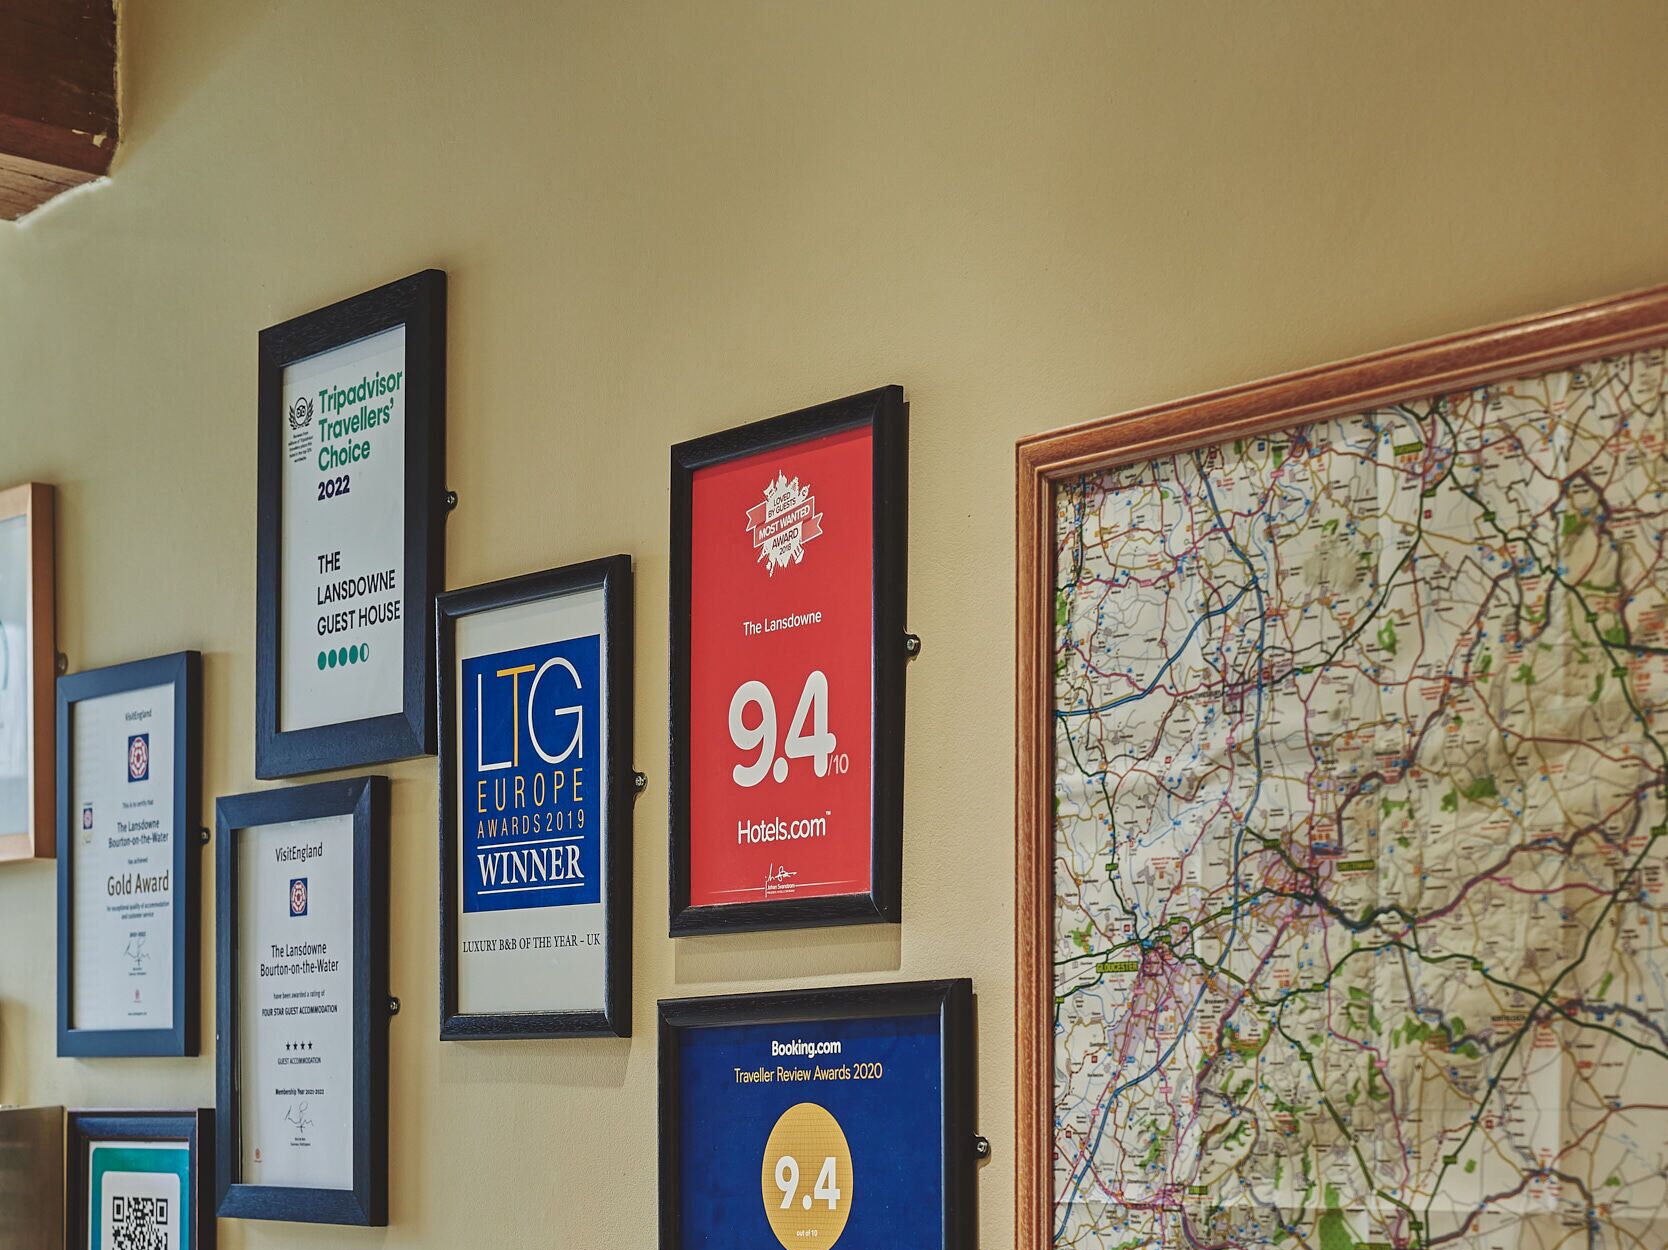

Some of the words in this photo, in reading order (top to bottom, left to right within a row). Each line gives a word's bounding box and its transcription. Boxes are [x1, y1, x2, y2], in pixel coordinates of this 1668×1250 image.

[318, 371, 403, 415] Tripadvisor
[318, 438, 370, 471] Choice
[318, 474, 350, 501] 2022
[774, 491, 790, 506] LOVED
[768, 508, 775, 519] BY
[775, 497, 796, 514] GUESTS
[759, 520, 780, 540] MOST
[780, 505, 810, 528] WANTED
[772, 527, 799, 550] AWARD
[318, 551, 341, 574] THE
[317, 569, 396, 606] LANSDOWNE
[317, 610, 356, 636] GUEST
[358, 600, 401, 628] HOUSE
[743, 621, 762, 636] The
[764, 611, 822, 633] Lansdowne
[477, 657, 583, 772] LTG
[728, 670, 837, 787] 9.4
[478, 767, 584, 813] EUROPE
[117, 821, 127, 832] The
[477, 814, 542, 839] AWARDS
[546, 809, 585, 832] 2019
[737, 816, 826, 844] Hotels.com
[275, 841, 323, 863] VisitEngland
[477, 845, 584, 887] WINNER
[107, 873, 132, 897] Gold
[135, 869, 169, 894] Award
[271, 944, 284, 958] The
[286, 941, 327, 958] Lansdowne
[463, 939, 497, 953] LUXURY
[499, 938, 517, 951] B&B
[519, 937, 531, 950] OF
[533, 936, 552, 949] THE
[554, 934, 578, 948] YEAR
[587, 933, 600, 946] UK
[260, 959, 339, 977] Bourton-on-the-Water
[771, 1039, 841, 1058] Booking.com
[734, 1066, 774, 1083] Traveller
[776, 1065, 811, 1082] Review
[813, 1064, 851, 1081] Awards
[853, 1062, 883, 1080] 2020
[774, 1155, 841, 1210] 9.4
